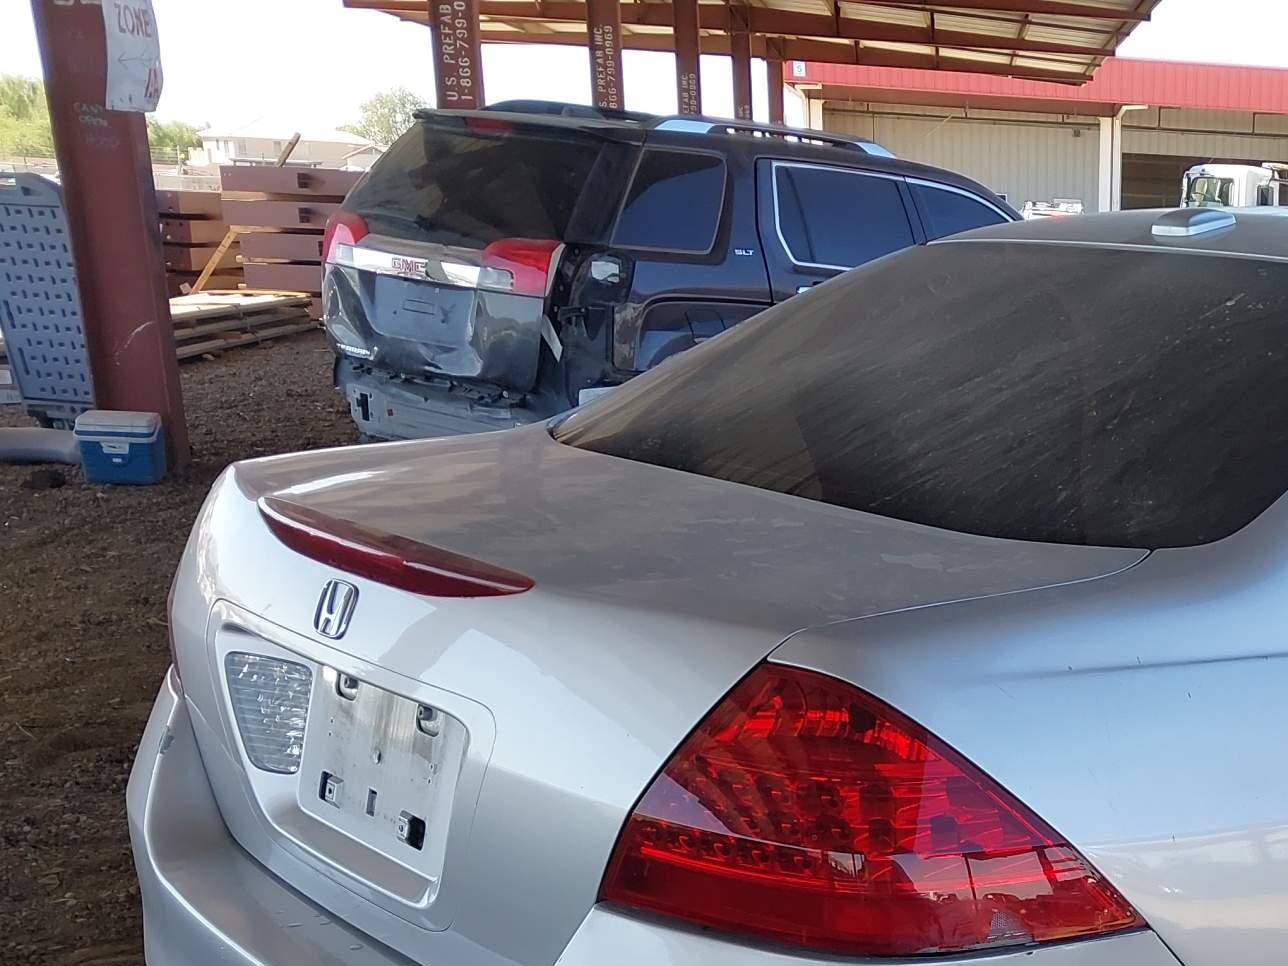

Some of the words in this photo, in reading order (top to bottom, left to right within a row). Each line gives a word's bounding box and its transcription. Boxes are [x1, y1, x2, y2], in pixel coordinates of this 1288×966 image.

[114, 3, 152, 38] ZONE
[439, 4, 456, 64] PREFAB
[445, 73, 459, 101] U.S.
[595, 50, 607, 93] PREFAB
[391, 257, 427, 273] GMC
